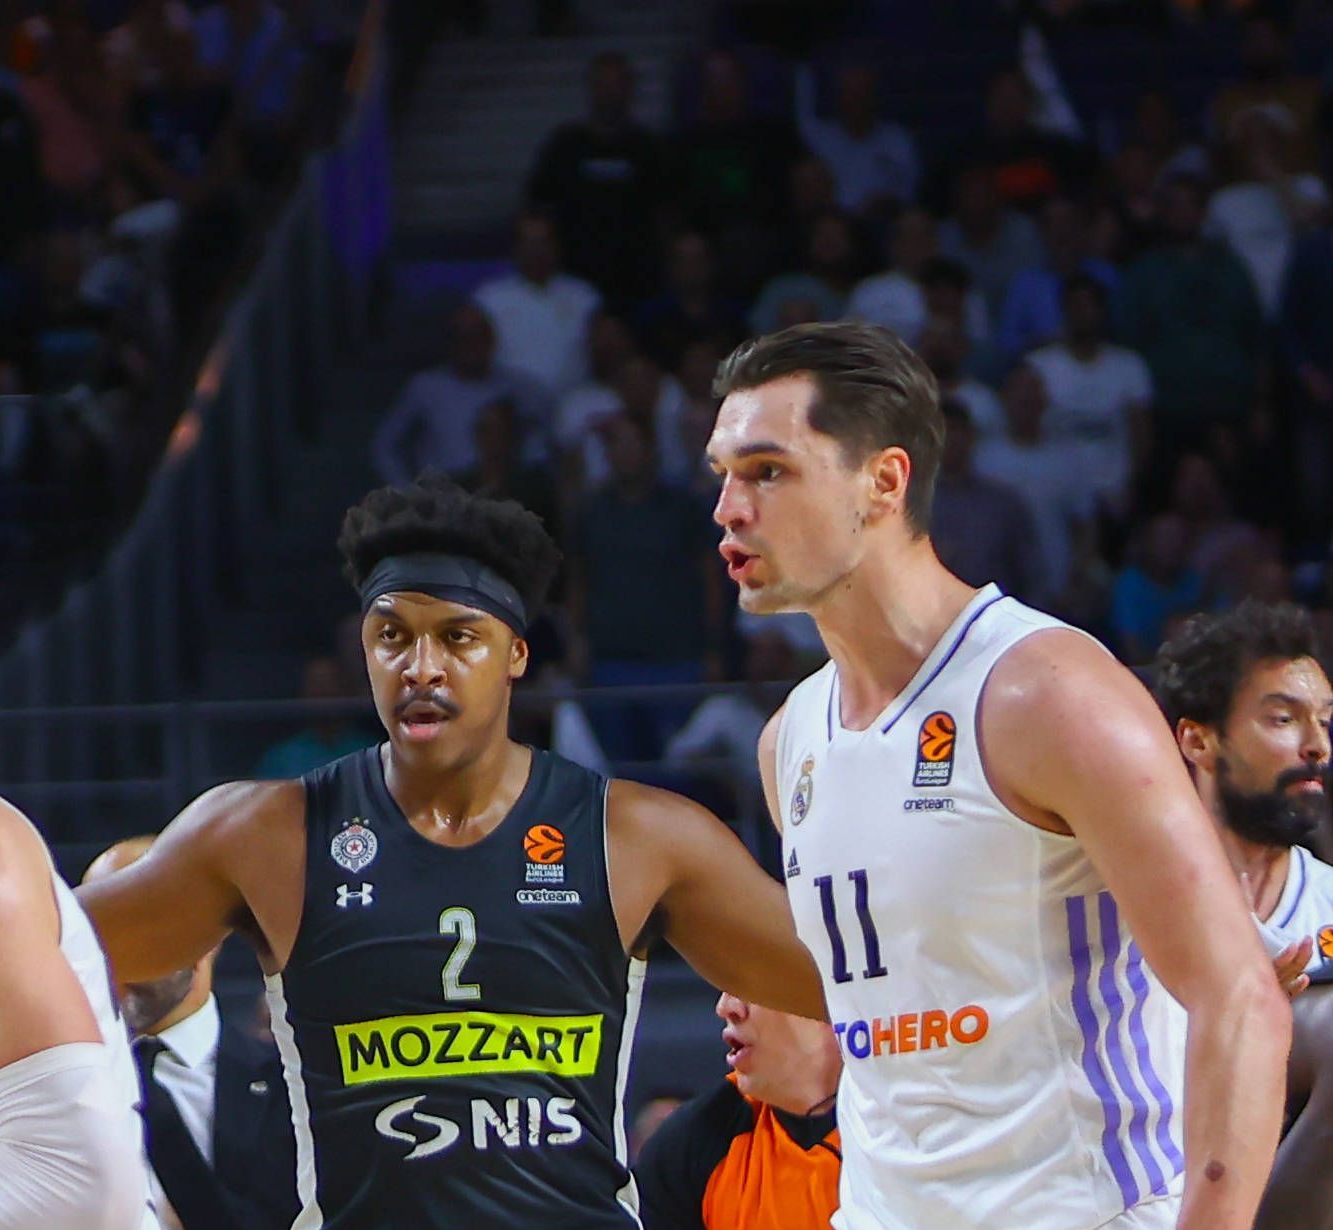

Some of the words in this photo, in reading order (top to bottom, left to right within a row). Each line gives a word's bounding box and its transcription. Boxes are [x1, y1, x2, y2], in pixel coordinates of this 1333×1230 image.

[517, 889, 580, 903] oneteam
[440, 906, 481, 1001] 2
[814, 869, 888, 984] 11
[347, 1022, 594, 1073] MOZZART
[470, 1096, 583, 1150] NIS
